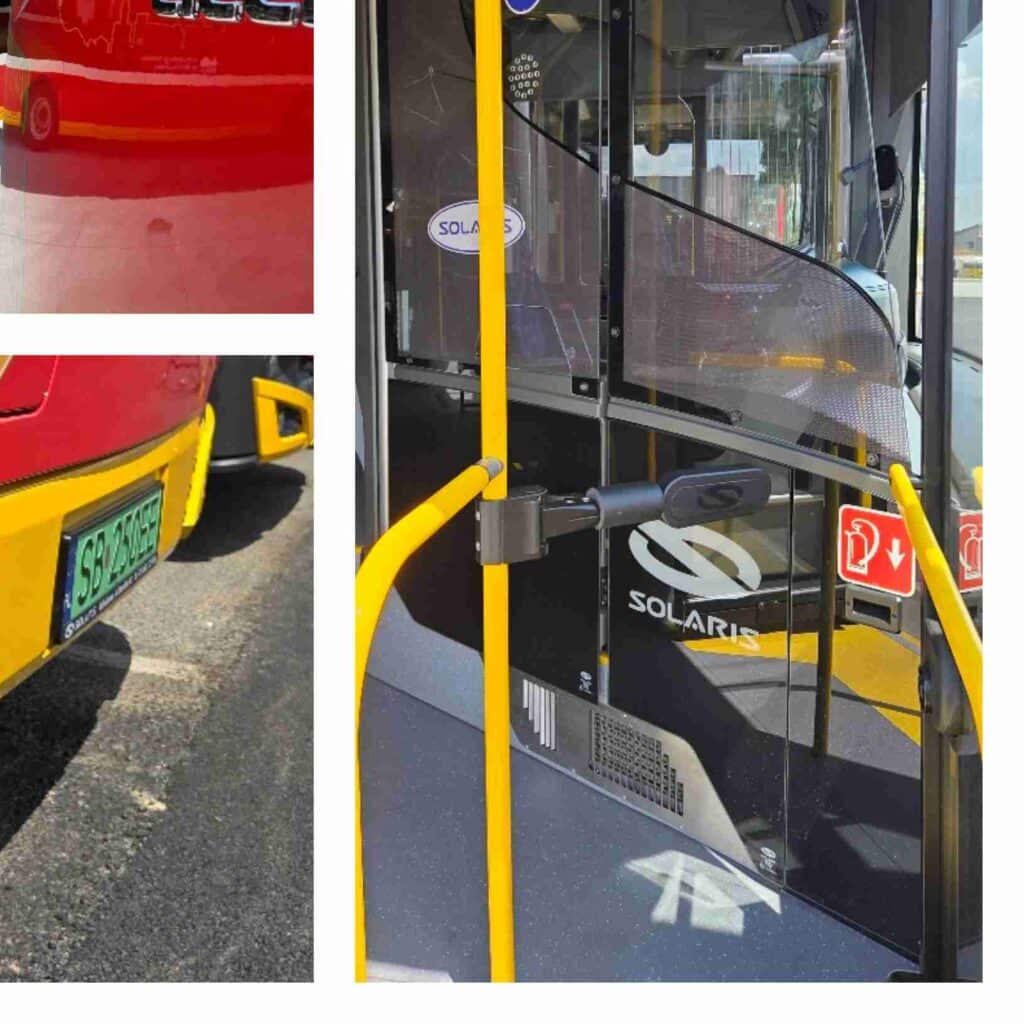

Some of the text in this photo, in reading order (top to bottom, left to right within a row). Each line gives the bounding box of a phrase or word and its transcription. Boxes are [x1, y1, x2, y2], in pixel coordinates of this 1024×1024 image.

[438, 218, 513, 236] SOLAS
[77, 529, 106, 607] SB
[627, 589, 761, 651] SOLARIS
